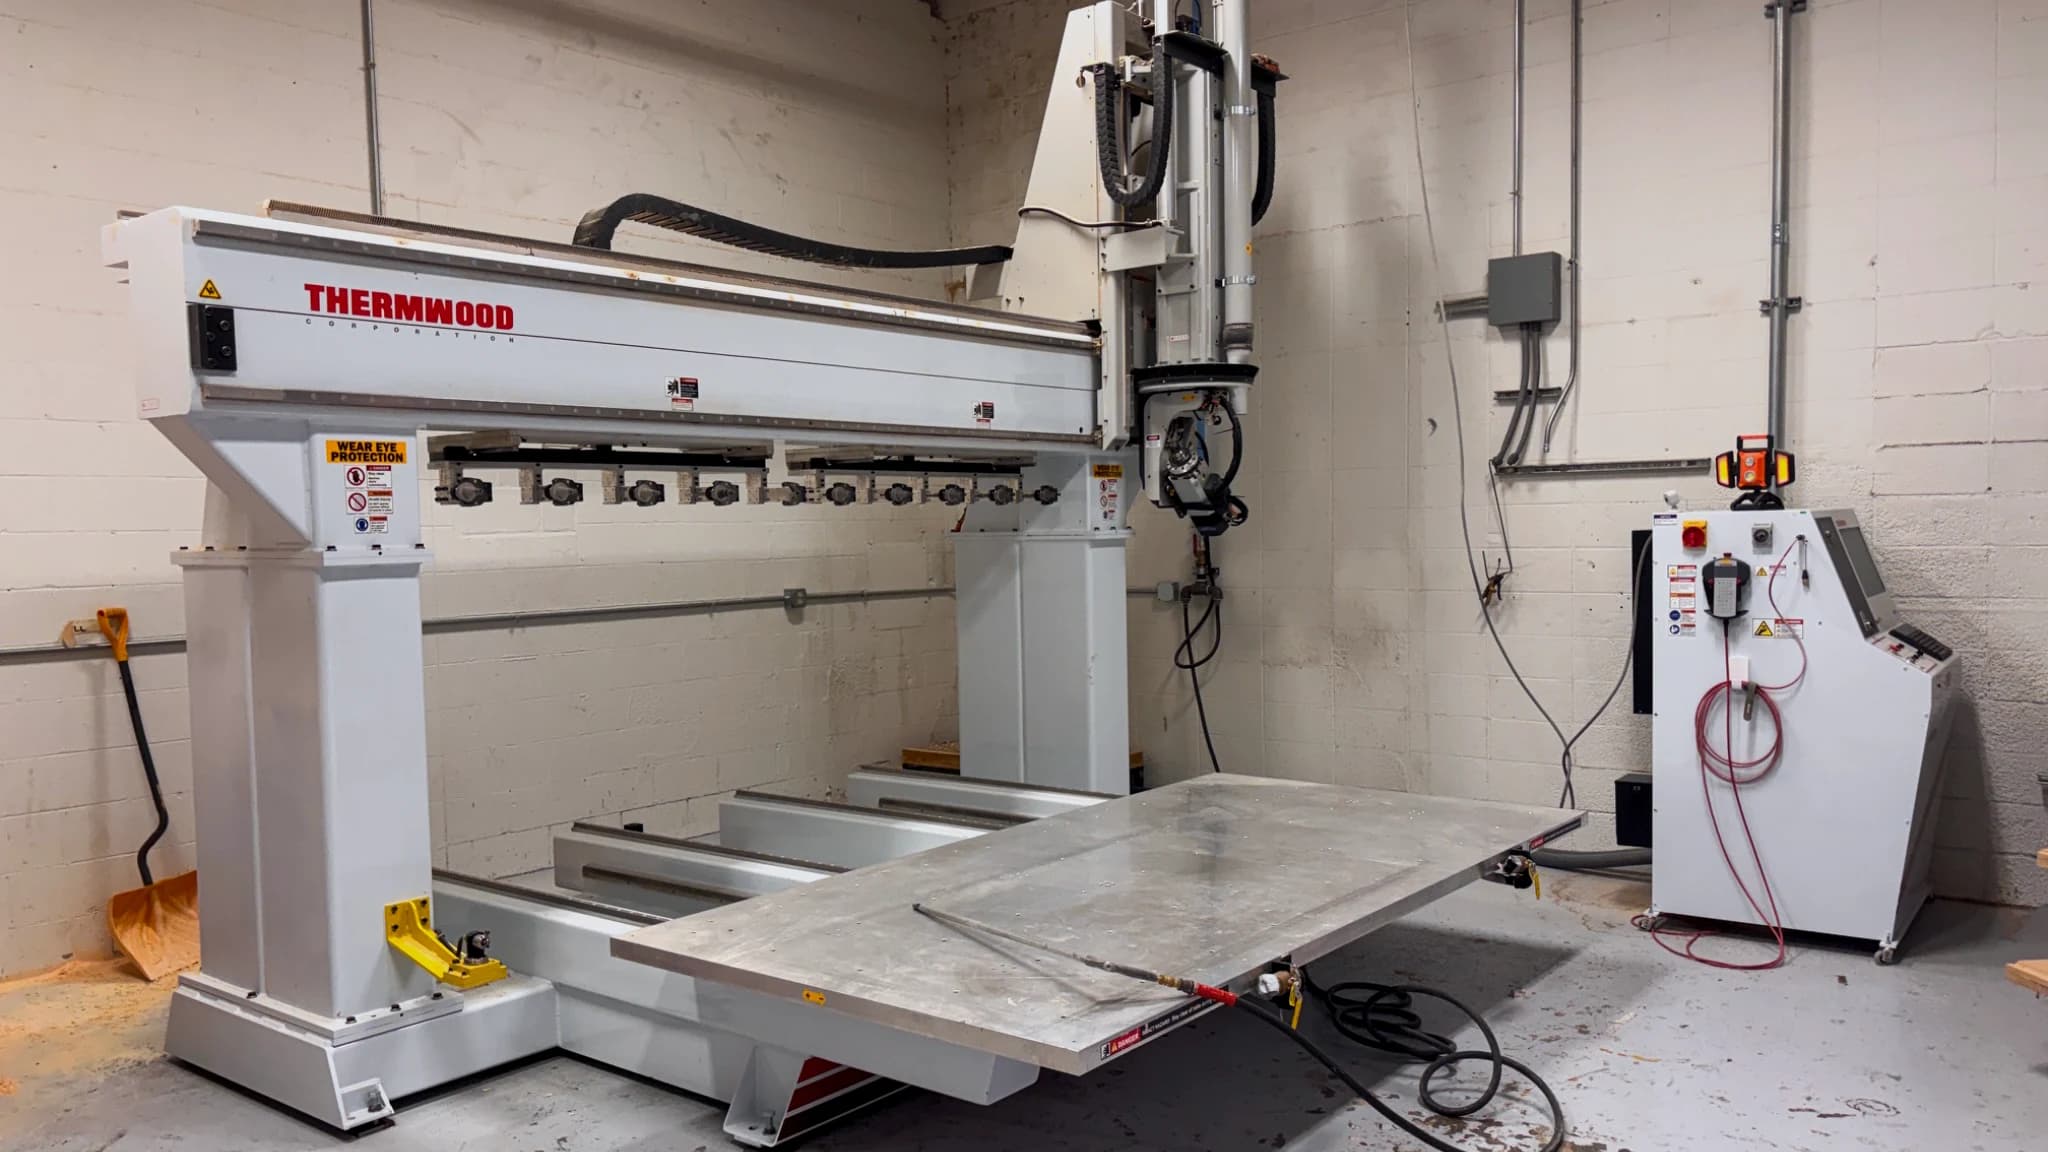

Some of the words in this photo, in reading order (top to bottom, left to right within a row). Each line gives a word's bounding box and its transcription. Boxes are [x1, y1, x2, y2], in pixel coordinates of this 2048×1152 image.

[304, 283, 514, 330] THERMWOOD
[305, 318, 515, 343] CORPORATION
[337, 441, 373, 452] WEAR
[376, 442, 397, 452] EYE
[331, 451, 404, 463] PROTECTION
